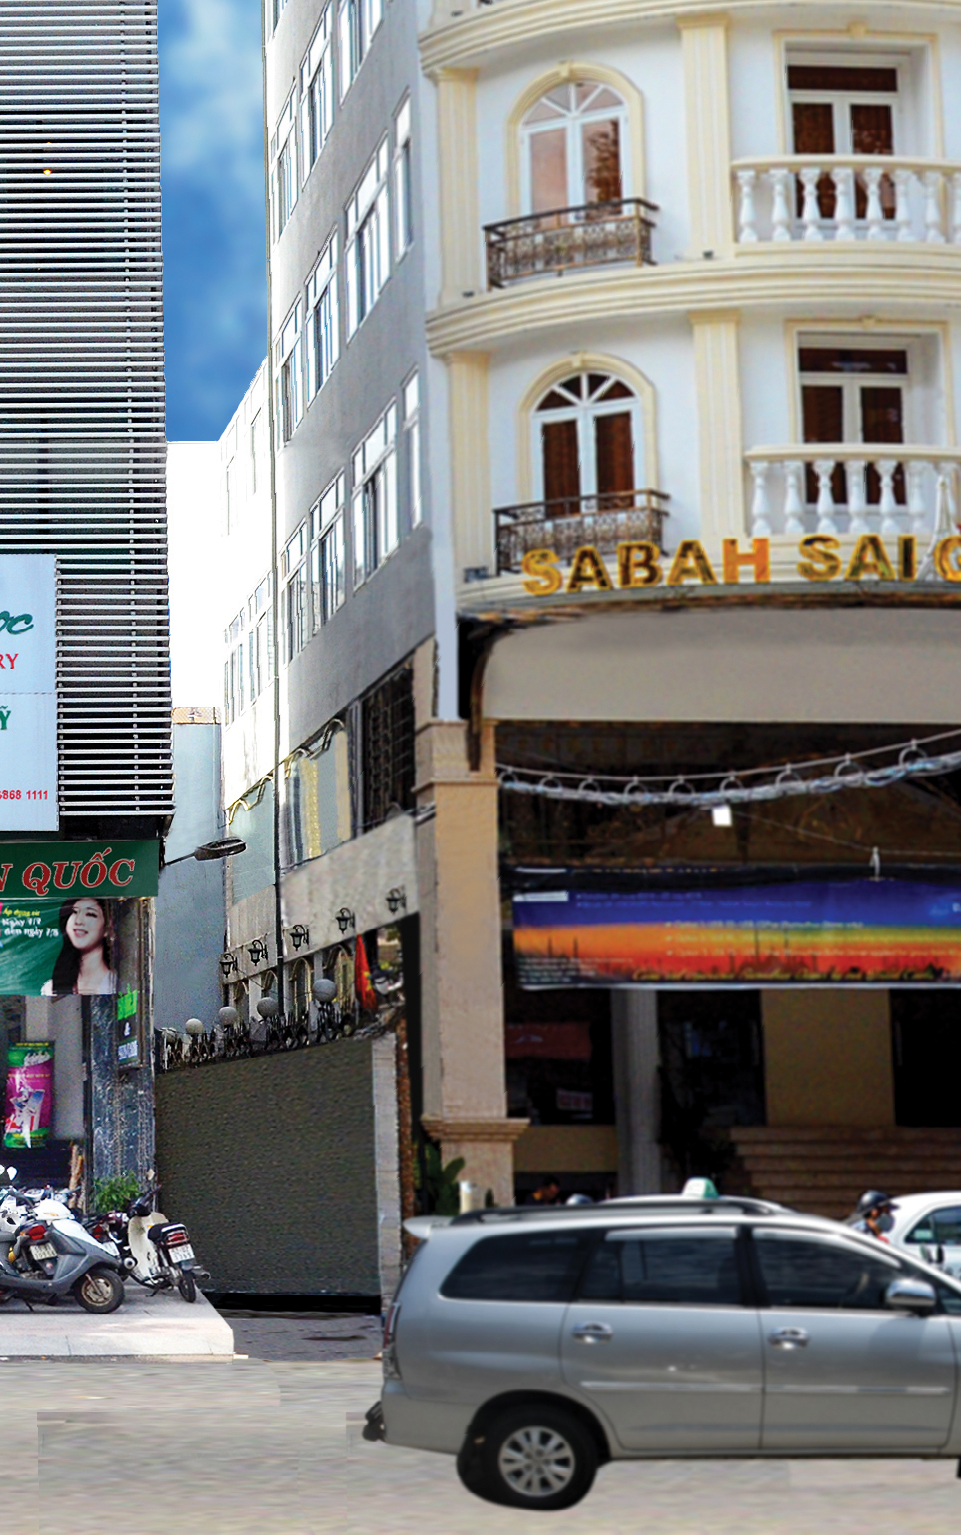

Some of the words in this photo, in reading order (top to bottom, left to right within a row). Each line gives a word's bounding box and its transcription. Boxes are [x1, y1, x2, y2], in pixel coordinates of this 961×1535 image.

[520, 537, 771, 596] SABAH
[26, 790, 48, 801] 1111
[22, 847, 136, 897] QUỐC
